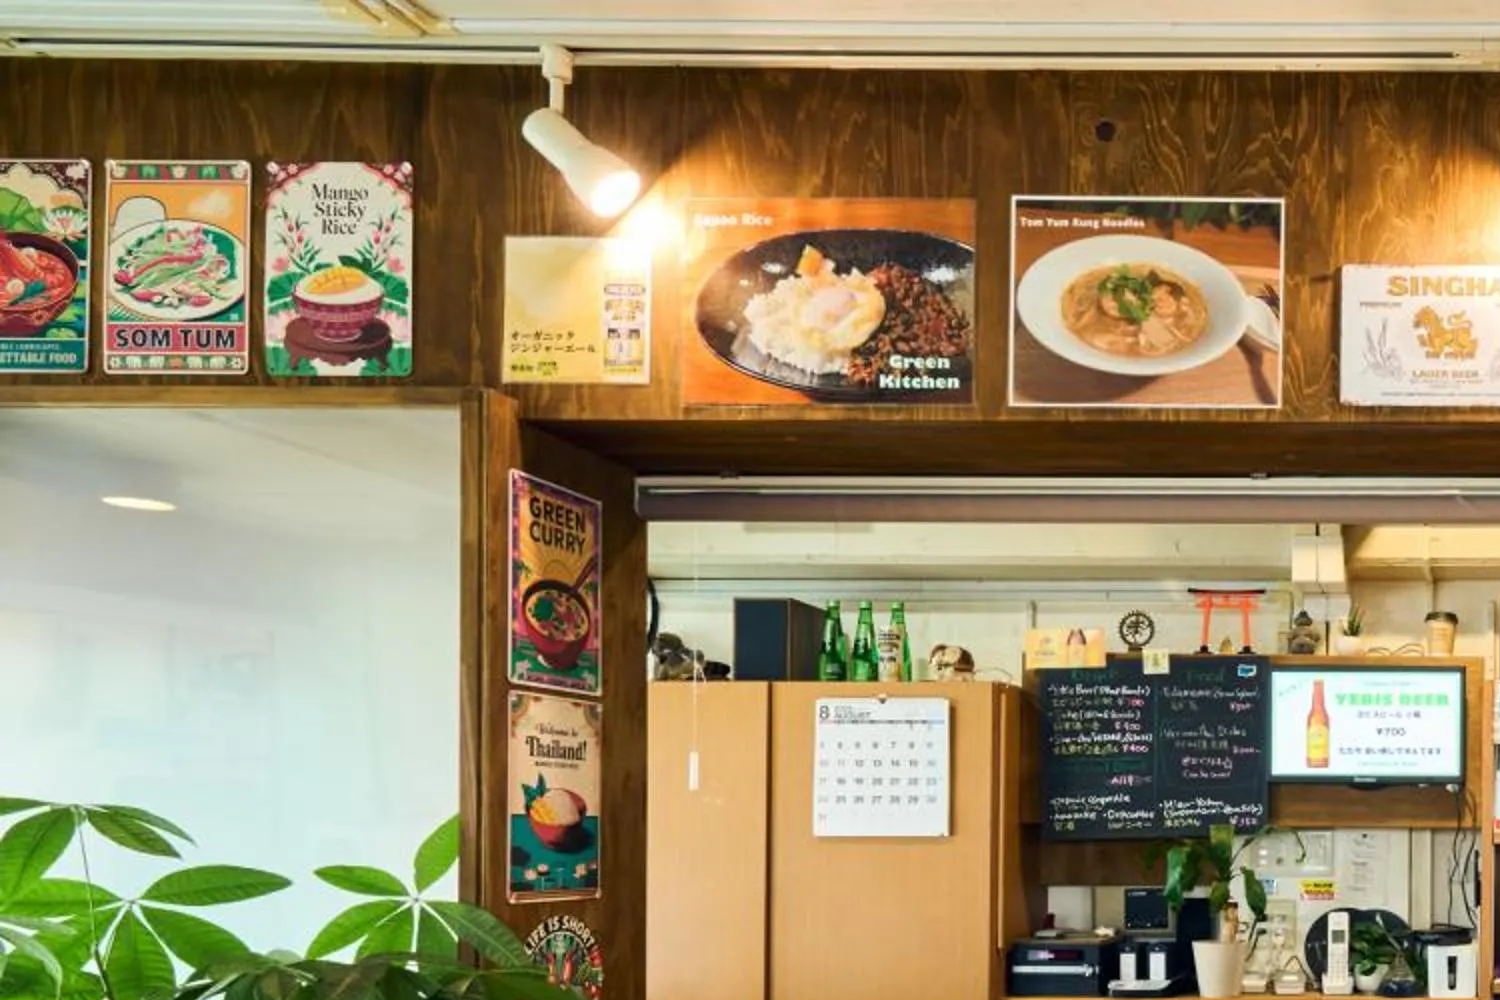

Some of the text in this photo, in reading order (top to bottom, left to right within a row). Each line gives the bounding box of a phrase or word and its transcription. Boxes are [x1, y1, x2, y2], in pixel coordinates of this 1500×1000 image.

[312, 183, 369, 201] Mango
[313, 201, 366, 222] Sticky
[322, 219, 357, 235] Rice
[115, 328, 236, 348] SOM TUM
[889, 354, 952, 369] Green
[879, 373, 960, 389] Kitchen
[529, 496, 586, 534] GREEN
[529, 520, 586, 557] CURRY
[525, 735, 587, 761] Thailand!
[524, 915, 596, 955] LIFE IS SHORT
